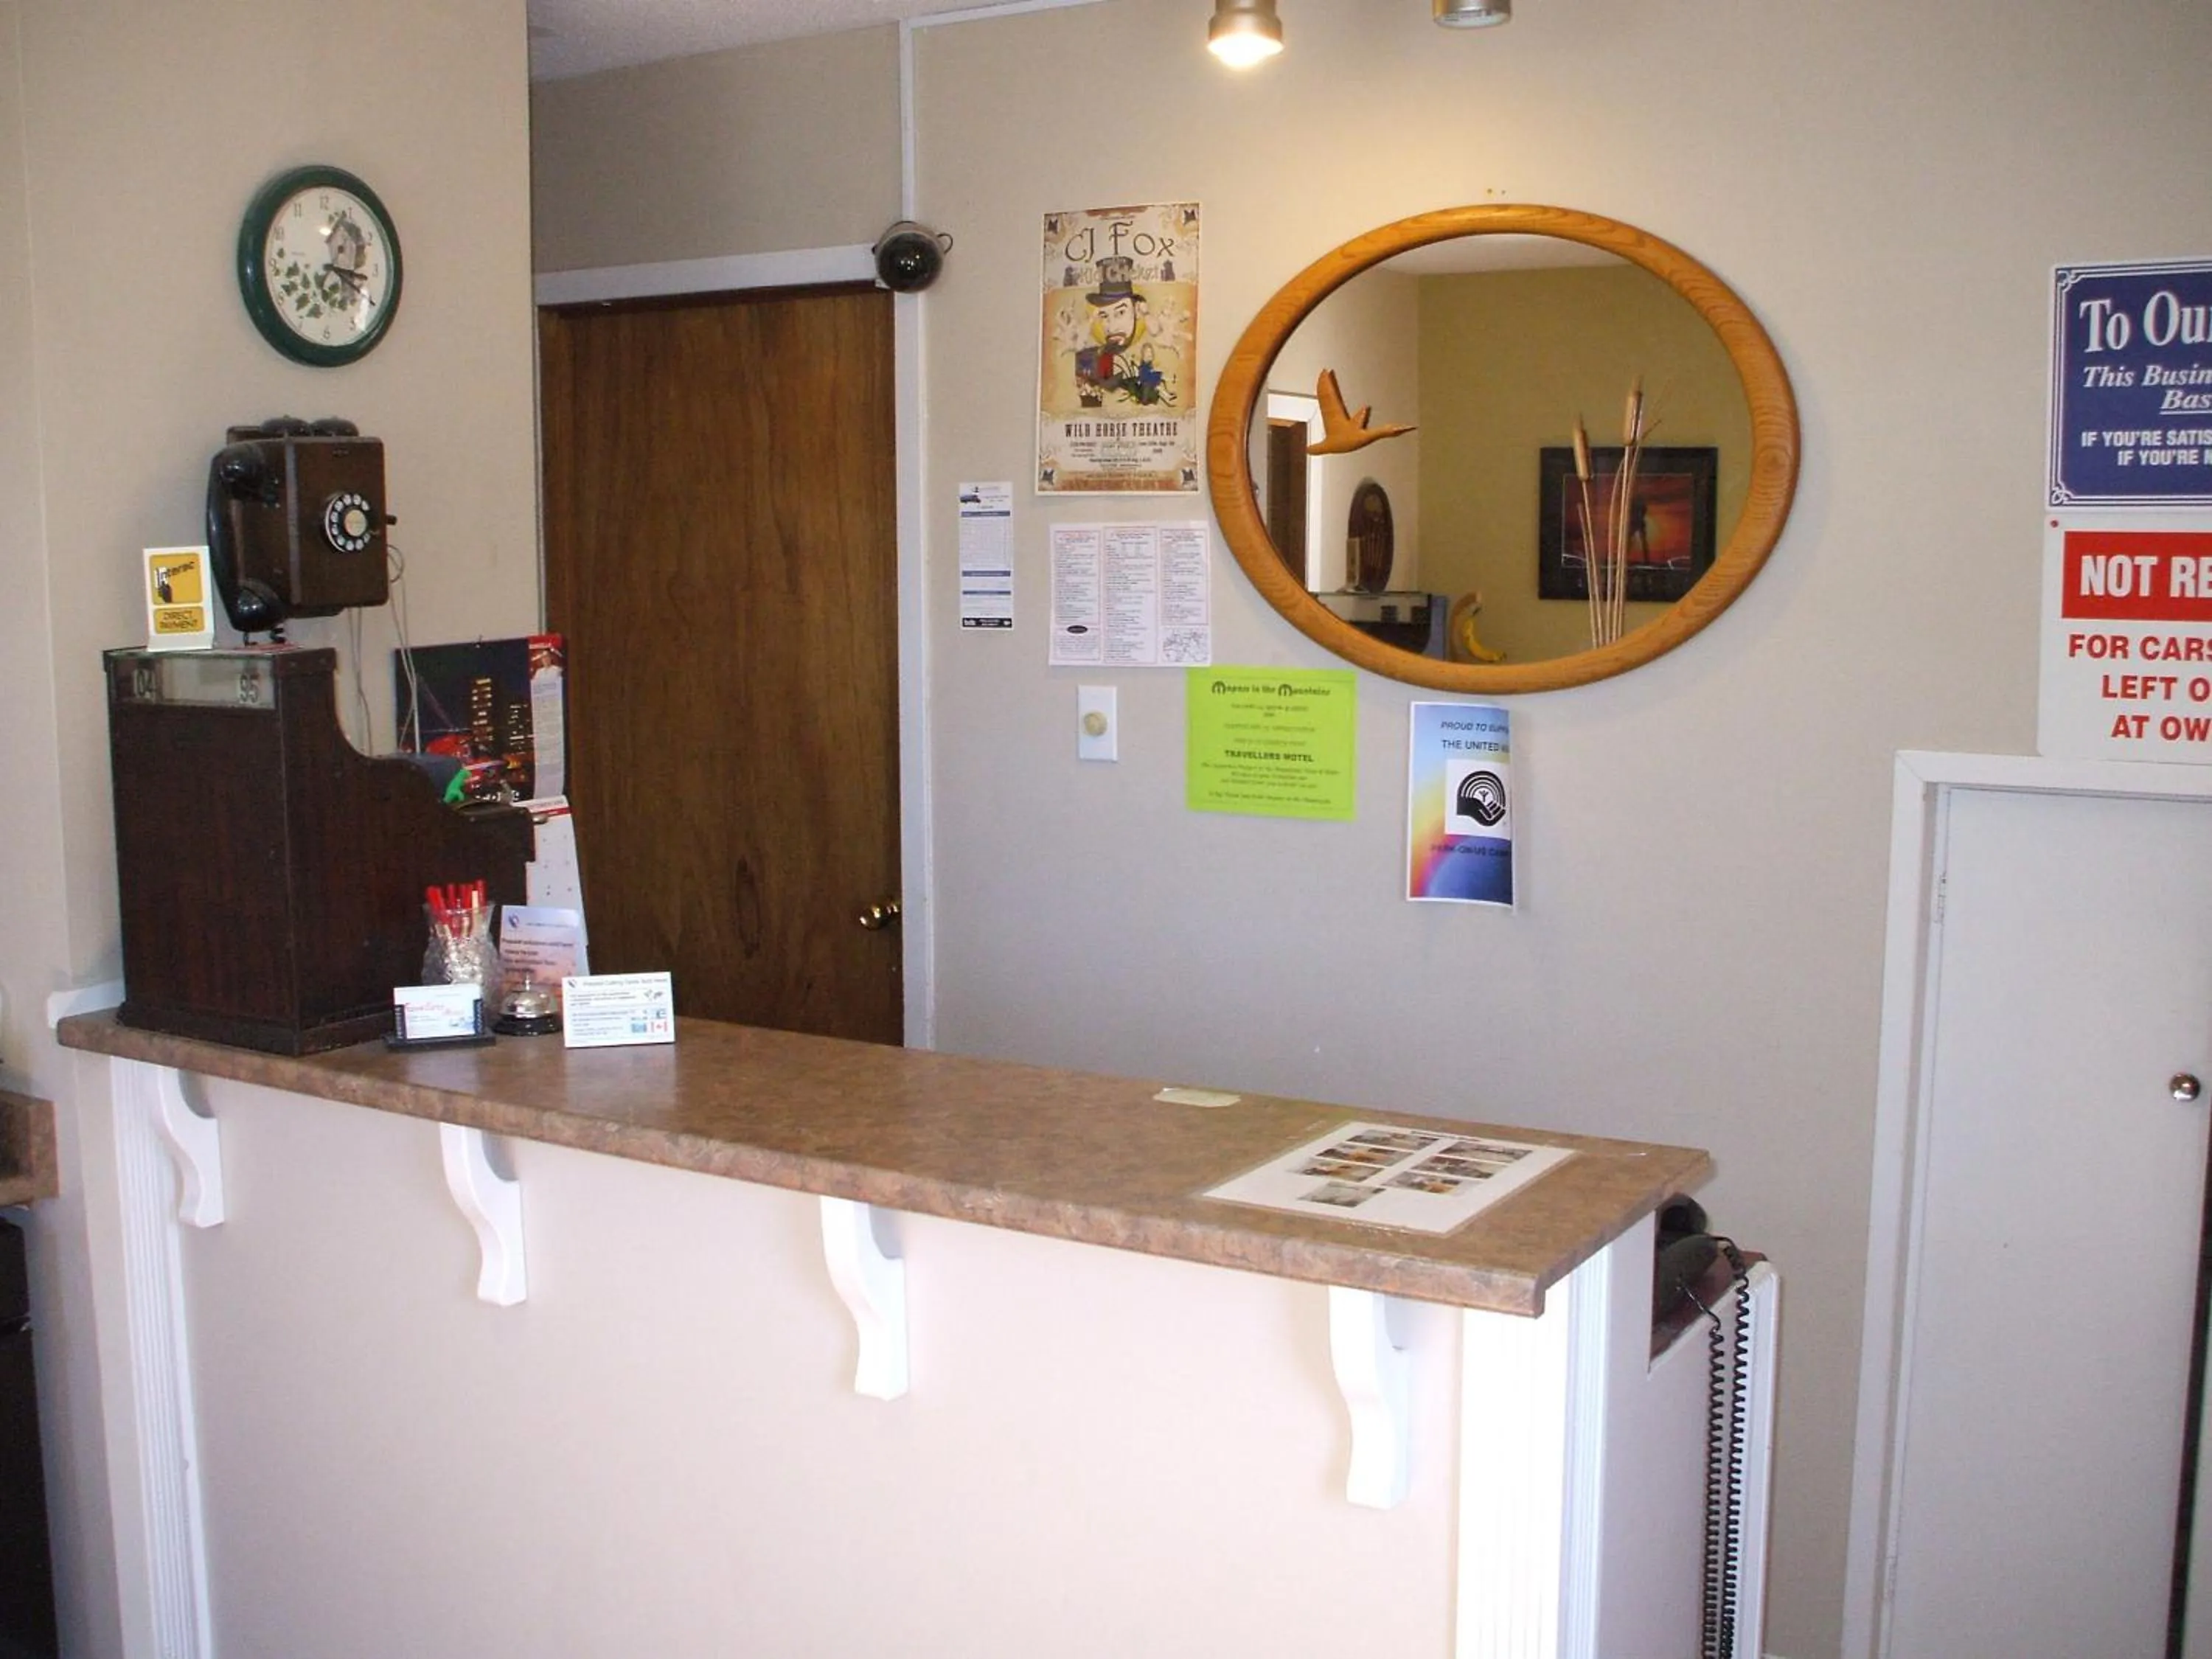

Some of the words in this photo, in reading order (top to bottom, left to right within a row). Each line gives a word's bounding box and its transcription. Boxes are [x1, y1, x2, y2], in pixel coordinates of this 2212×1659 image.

[1065, 228, 1095, 263] CJ
[1108, 220, 1175, 257] Fox
[2079, 298, 2131, 353] To
[2143, 291, 2212, 347] Ou
[2082, 367, 2135, 388] This
[1065, 423, 1091, 437] WILD
[1095, 422, 1127, 437] HORSE
[1132, 421, 1178, 437] THEATRE
[2081, 431, 2098, 447] IF
[2102, 431, 2163, 447] YOU'RE
[2118, 451, 2134, 465] IF
[2139, 449, 2199, 465] YOU'RE
[2080, 555, 2158, 597] NOT
[2068, 634, 2129, 658] FOR
[2139, 636, 2212, 661] CAR
[2102, 675, 2178, 700] LEFT
[1441, 721, 1473, 731] PROUD
[1475, 723, 1487, 732] TO
[2111, 714, 2150, 738] AT
[1224, 748, 1281, 760] TRAVELLERS
[1284, 751, 1315, 762] MOTEL
[1441, 739, 1462, 750] THE
[1465, 740, 1499, 751] UNITED
